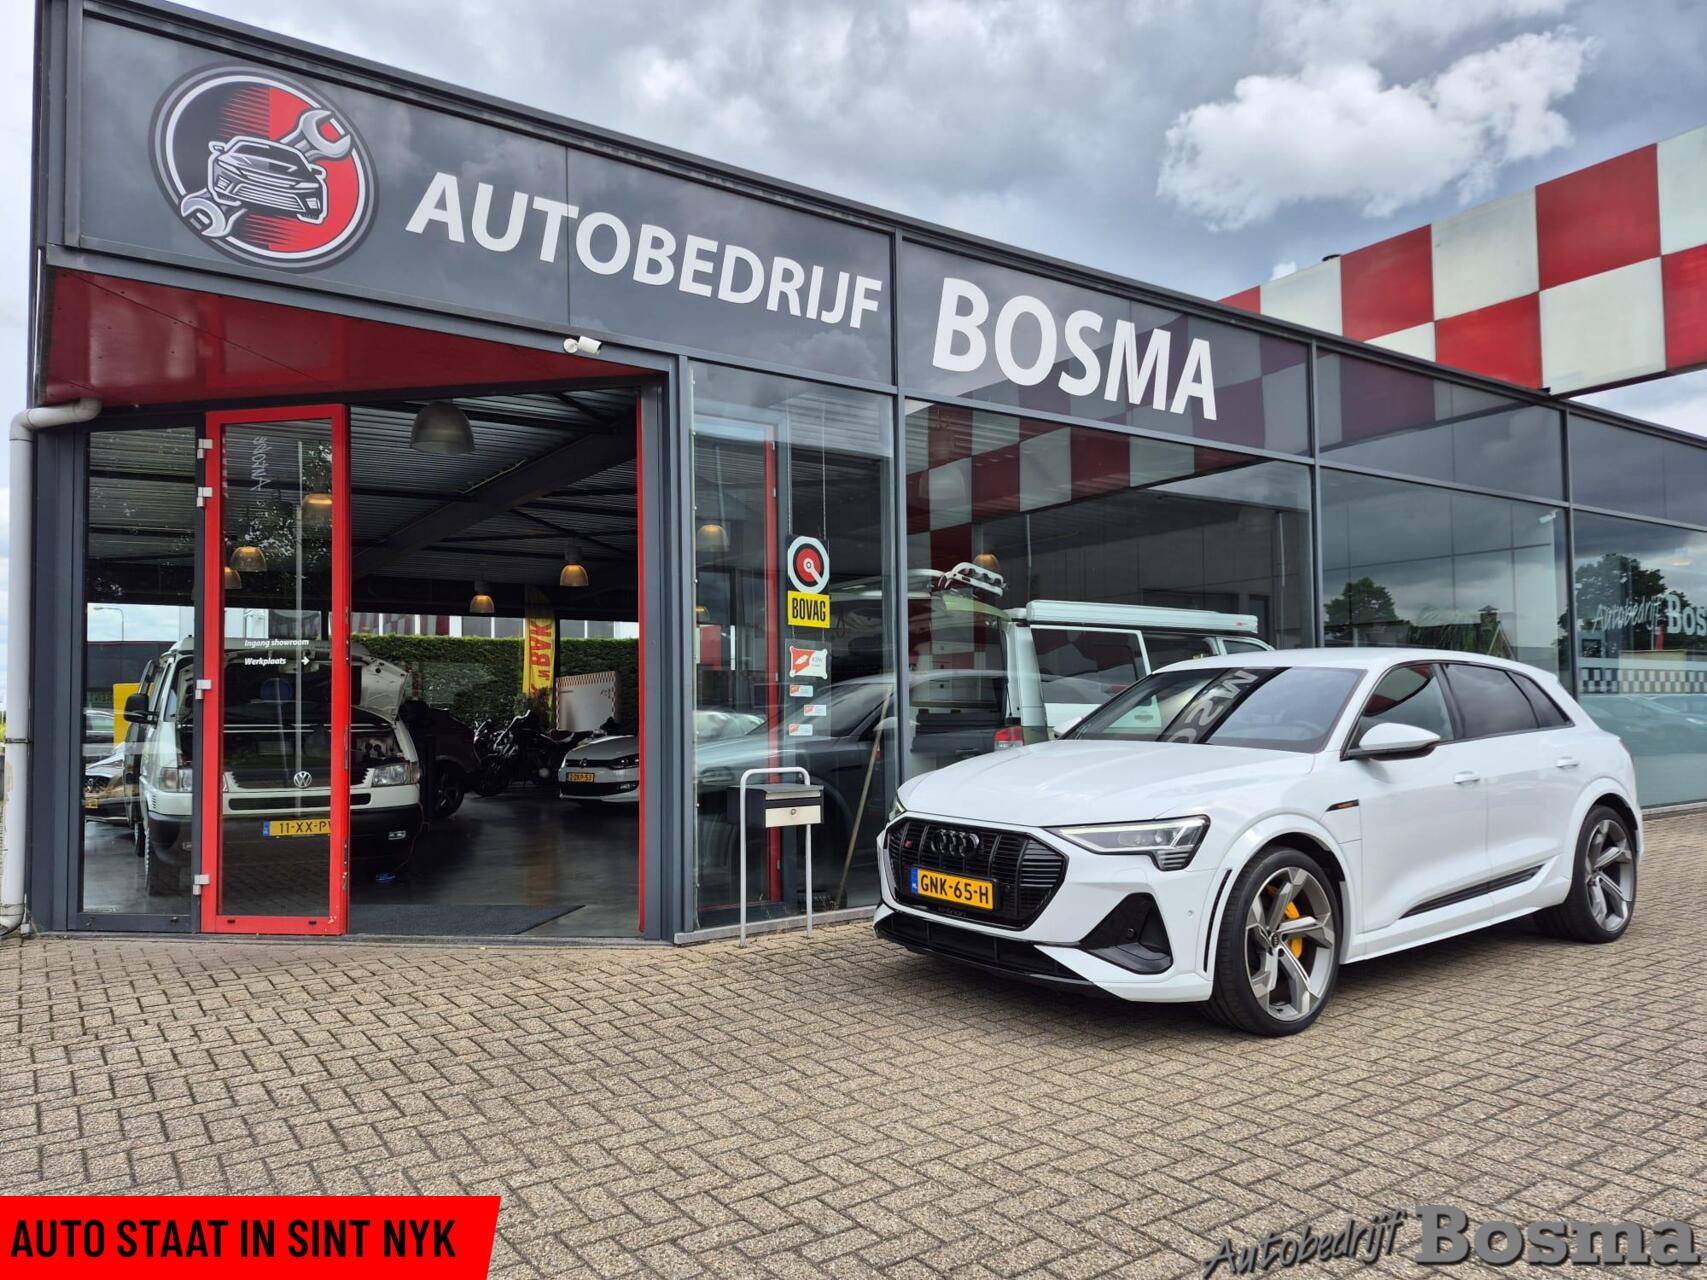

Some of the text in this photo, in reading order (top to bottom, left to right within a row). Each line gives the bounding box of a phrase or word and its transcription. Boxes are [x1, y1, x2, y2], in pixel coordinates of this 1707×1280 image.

[405, 172, 1217, 421] AUTOBEDRIJF BOSMA
[792, 597, 826, 622] BOVAG
[244, 638, 310, 649] Ingang showroom
[244, 657, 287, 667] Werkplaats
[920, 874, 989, 905] GNK-65-H
